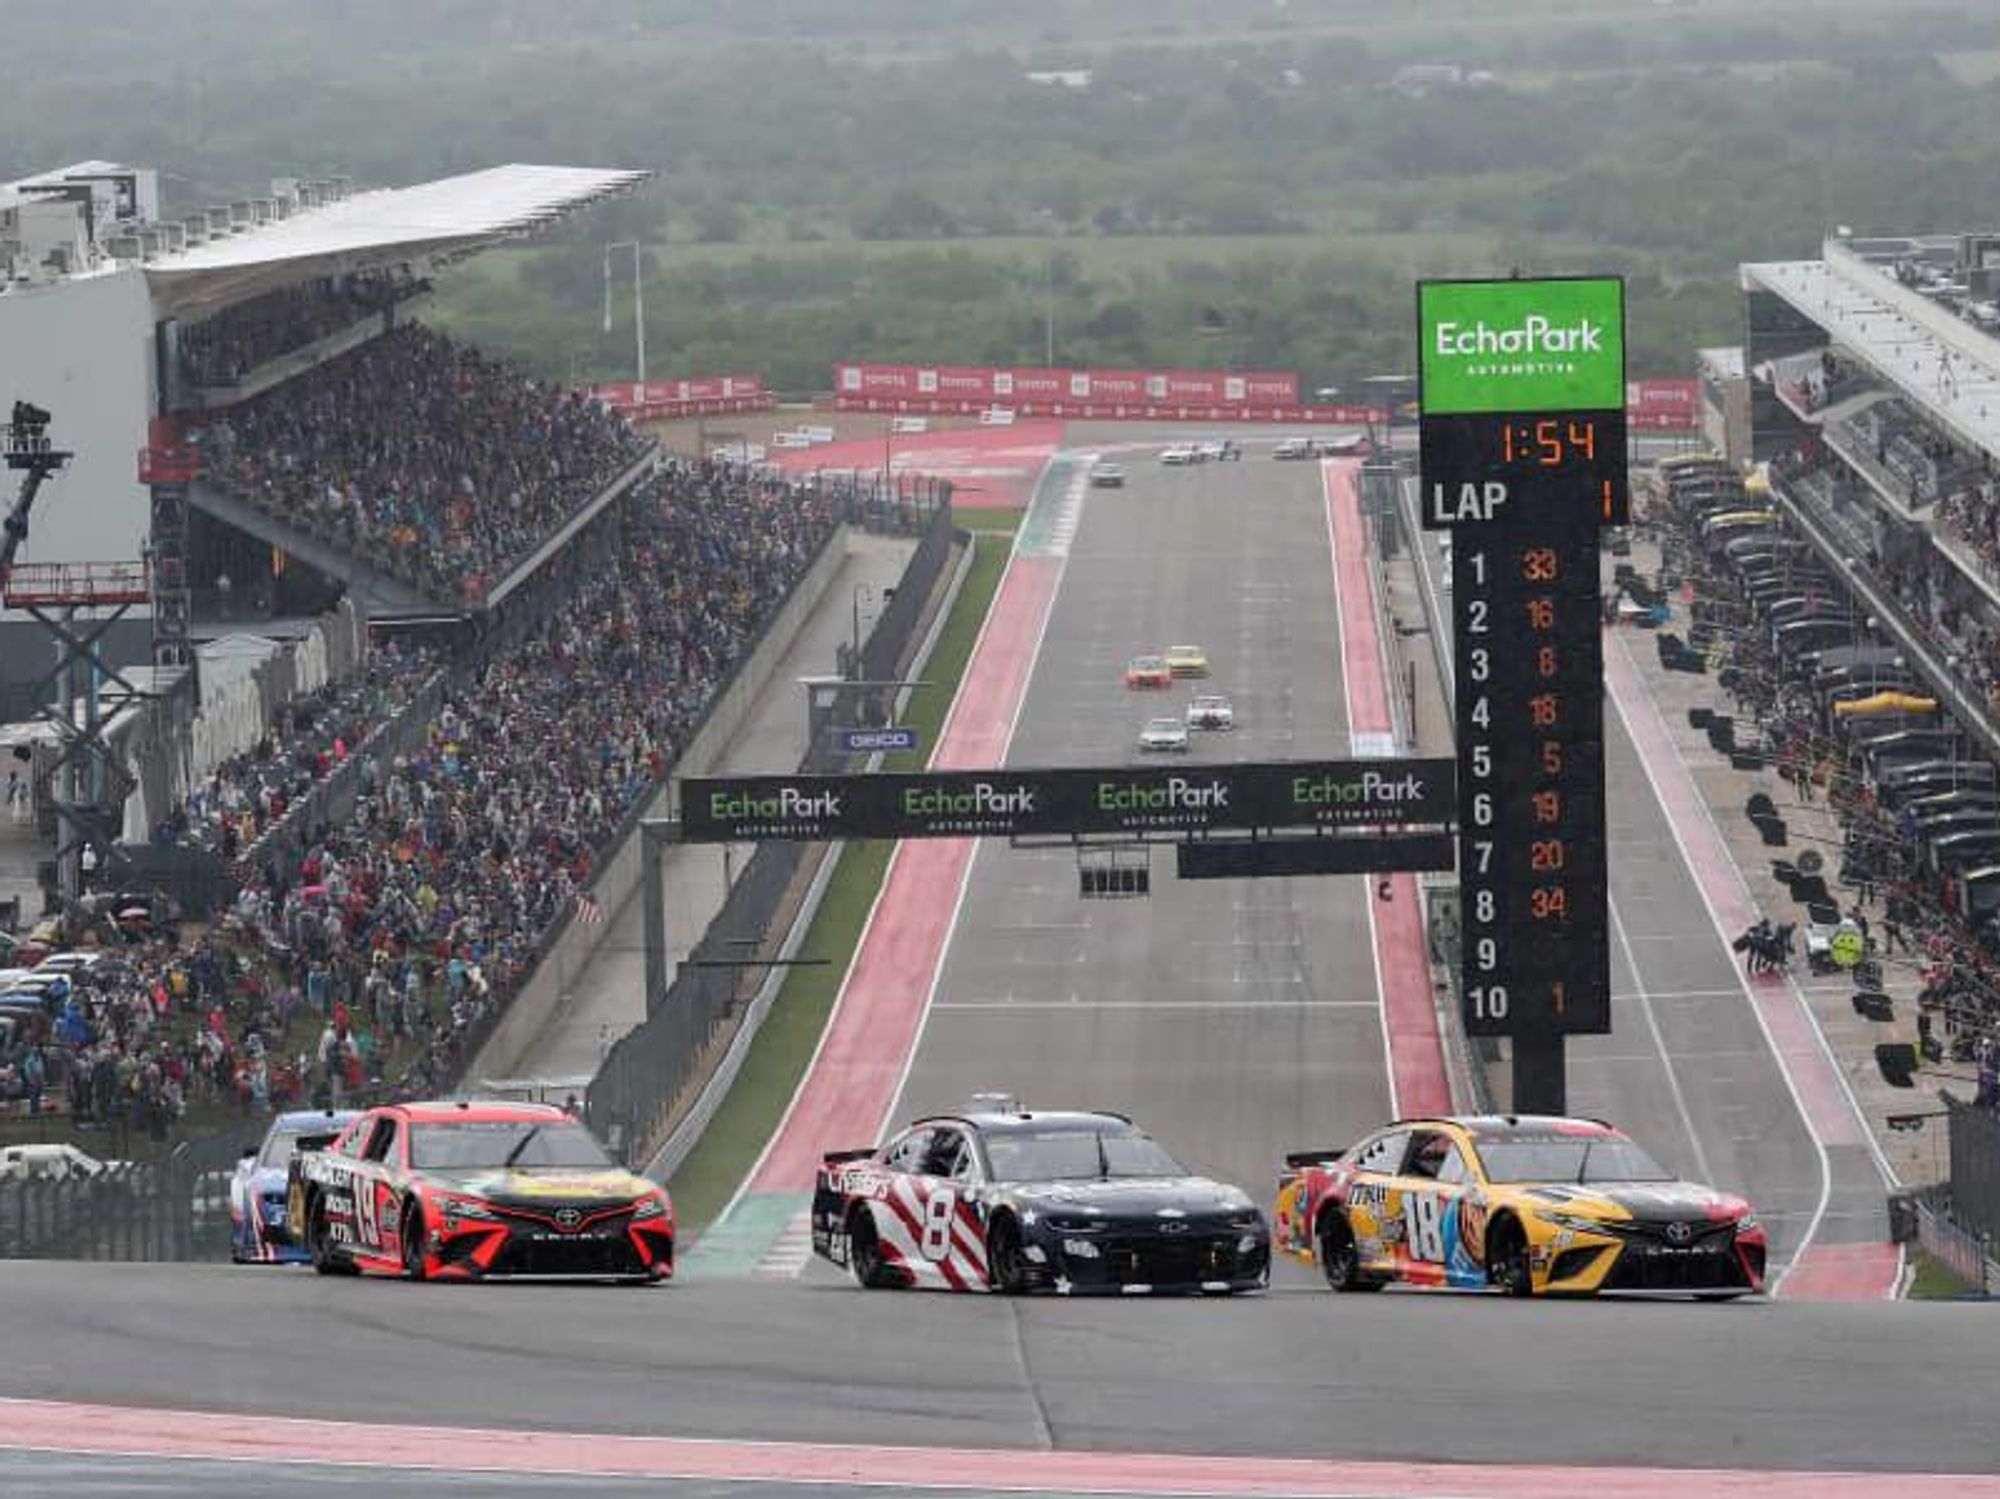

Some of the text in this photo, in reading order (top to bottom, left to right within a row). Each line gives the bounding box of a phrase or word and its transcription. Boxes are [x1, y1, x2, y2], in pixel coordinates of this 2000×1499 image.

[1435, 315, 1603, 355] EchoPark
[1502, 420, 1594, 464] 1:54
[1433, 480, 1613, 521] LAP 1
[1469, 548, 1557, 585] 1 33
[1468, 599, 1554, 632] 2 16
[1471, 649, 1489, 680] 3
[1471, 696, 1556, 730] 4 18
[1473, 745, 1491, 778] 5
[710, 787, 842, 820] EchoPark
[905, 782, 1035, 815] EchoPark
[1097, 777, 1229, 811] EchoPark
[1292, 770, 1425, 804] EchoPark
[1473, 790, 1559, 826] 6 19
[1474, 841, 1564, 874] 7 20
[1476, 888, 1566, 923] 8 34
[1478, 938, 1497, 971] 9
[1469, 986, 1508, 1019] 10
[352, 1173, 380, 1245] 19
[921, 1187, 955, 1261] 8
[1402, 1191, 1446, 1264] 18
